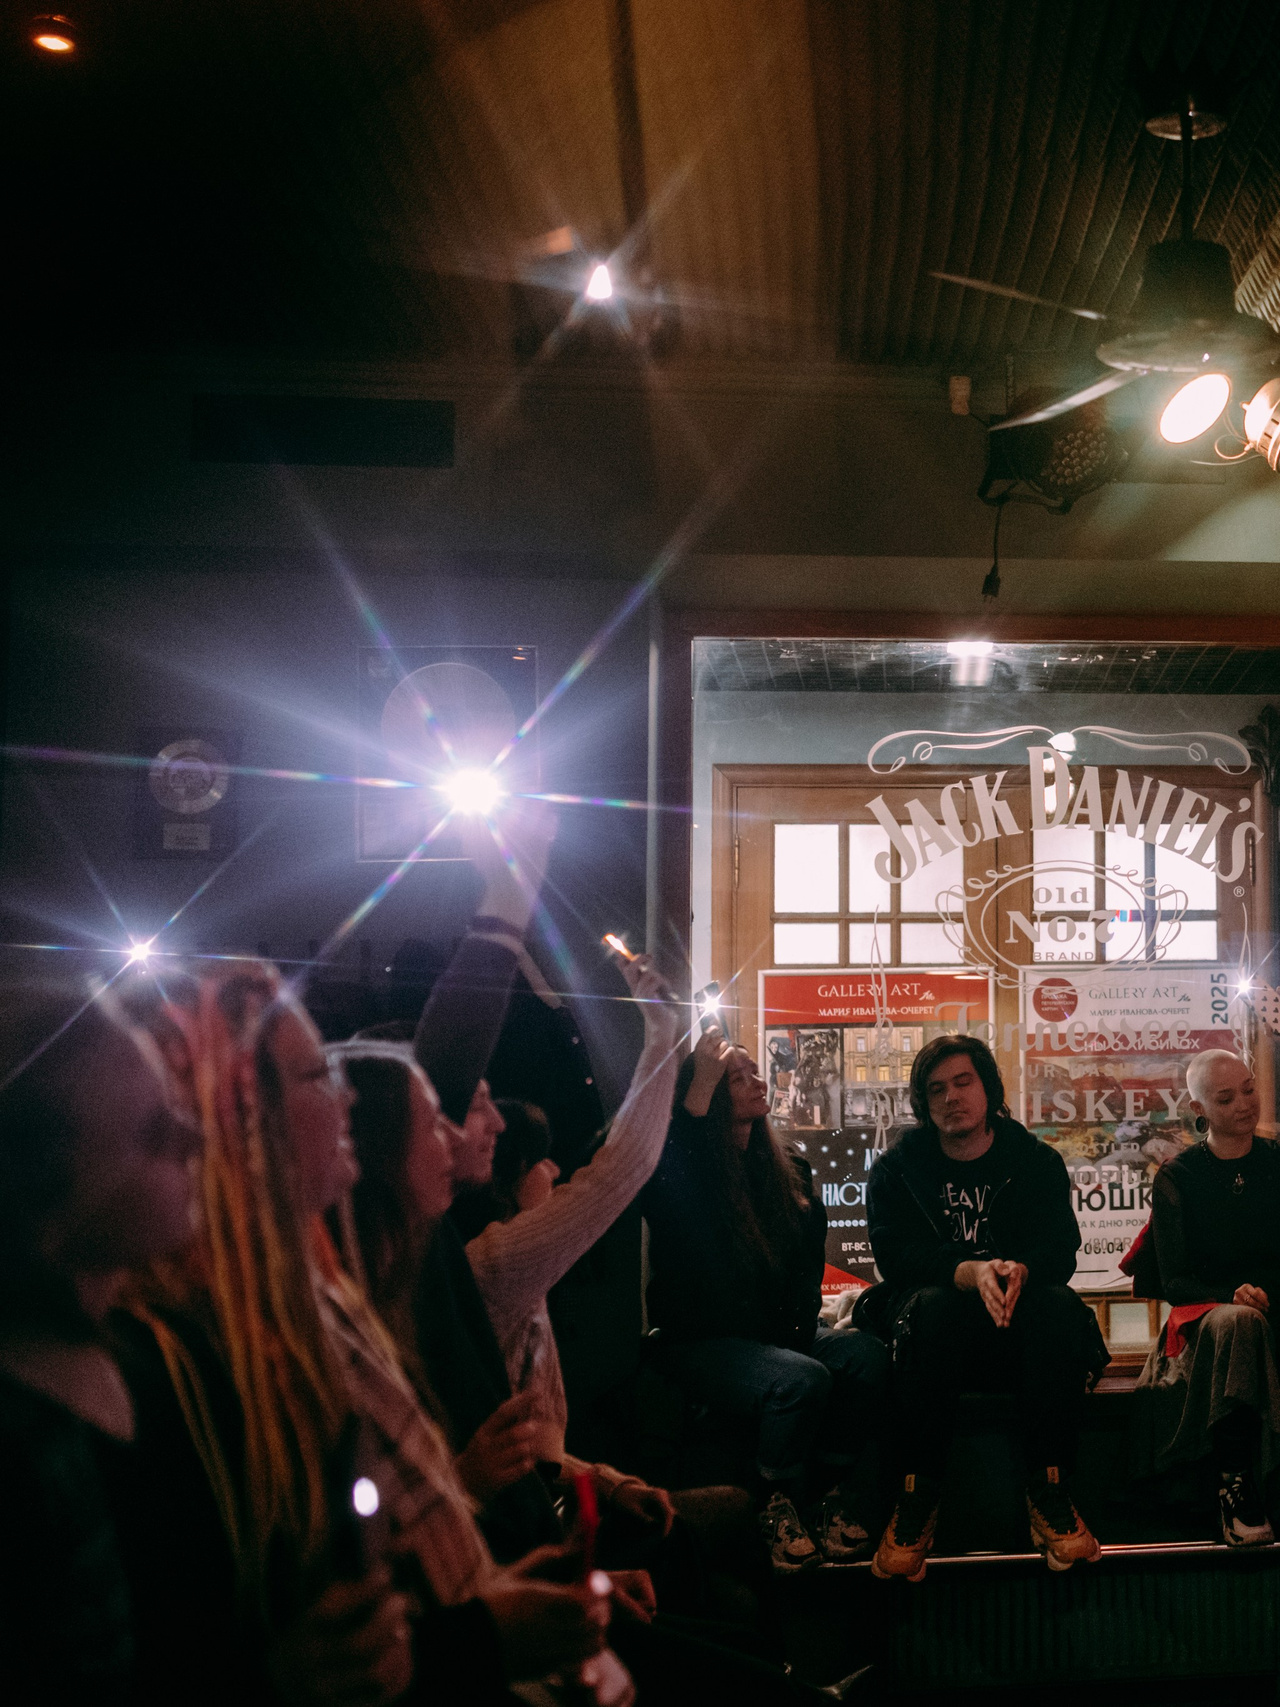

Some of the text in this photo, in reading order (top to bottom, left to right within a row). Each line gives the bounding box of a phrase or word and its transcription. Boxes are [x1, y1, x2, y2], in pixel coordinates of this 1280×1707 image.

[865, 770, 1024, 884] JACK
[1032, 886, 1090, 904] Old
[1033, 951, 1095, 961] BRAND
[817, 984, 884, 998] GALLERY
[890, 982, 921, 996] ART
[1088, 986, 1148, 999] GALLERY
[1152, 986, 1180, 999] ART
[1210, 972, 1229, 1025] 2025
[1010, 1087, 1189, 1124] ISKEY
[1076, 1187, 1152, 1212] ЮШК
[1098, 1219, 1123, 1229] ДНЮ
